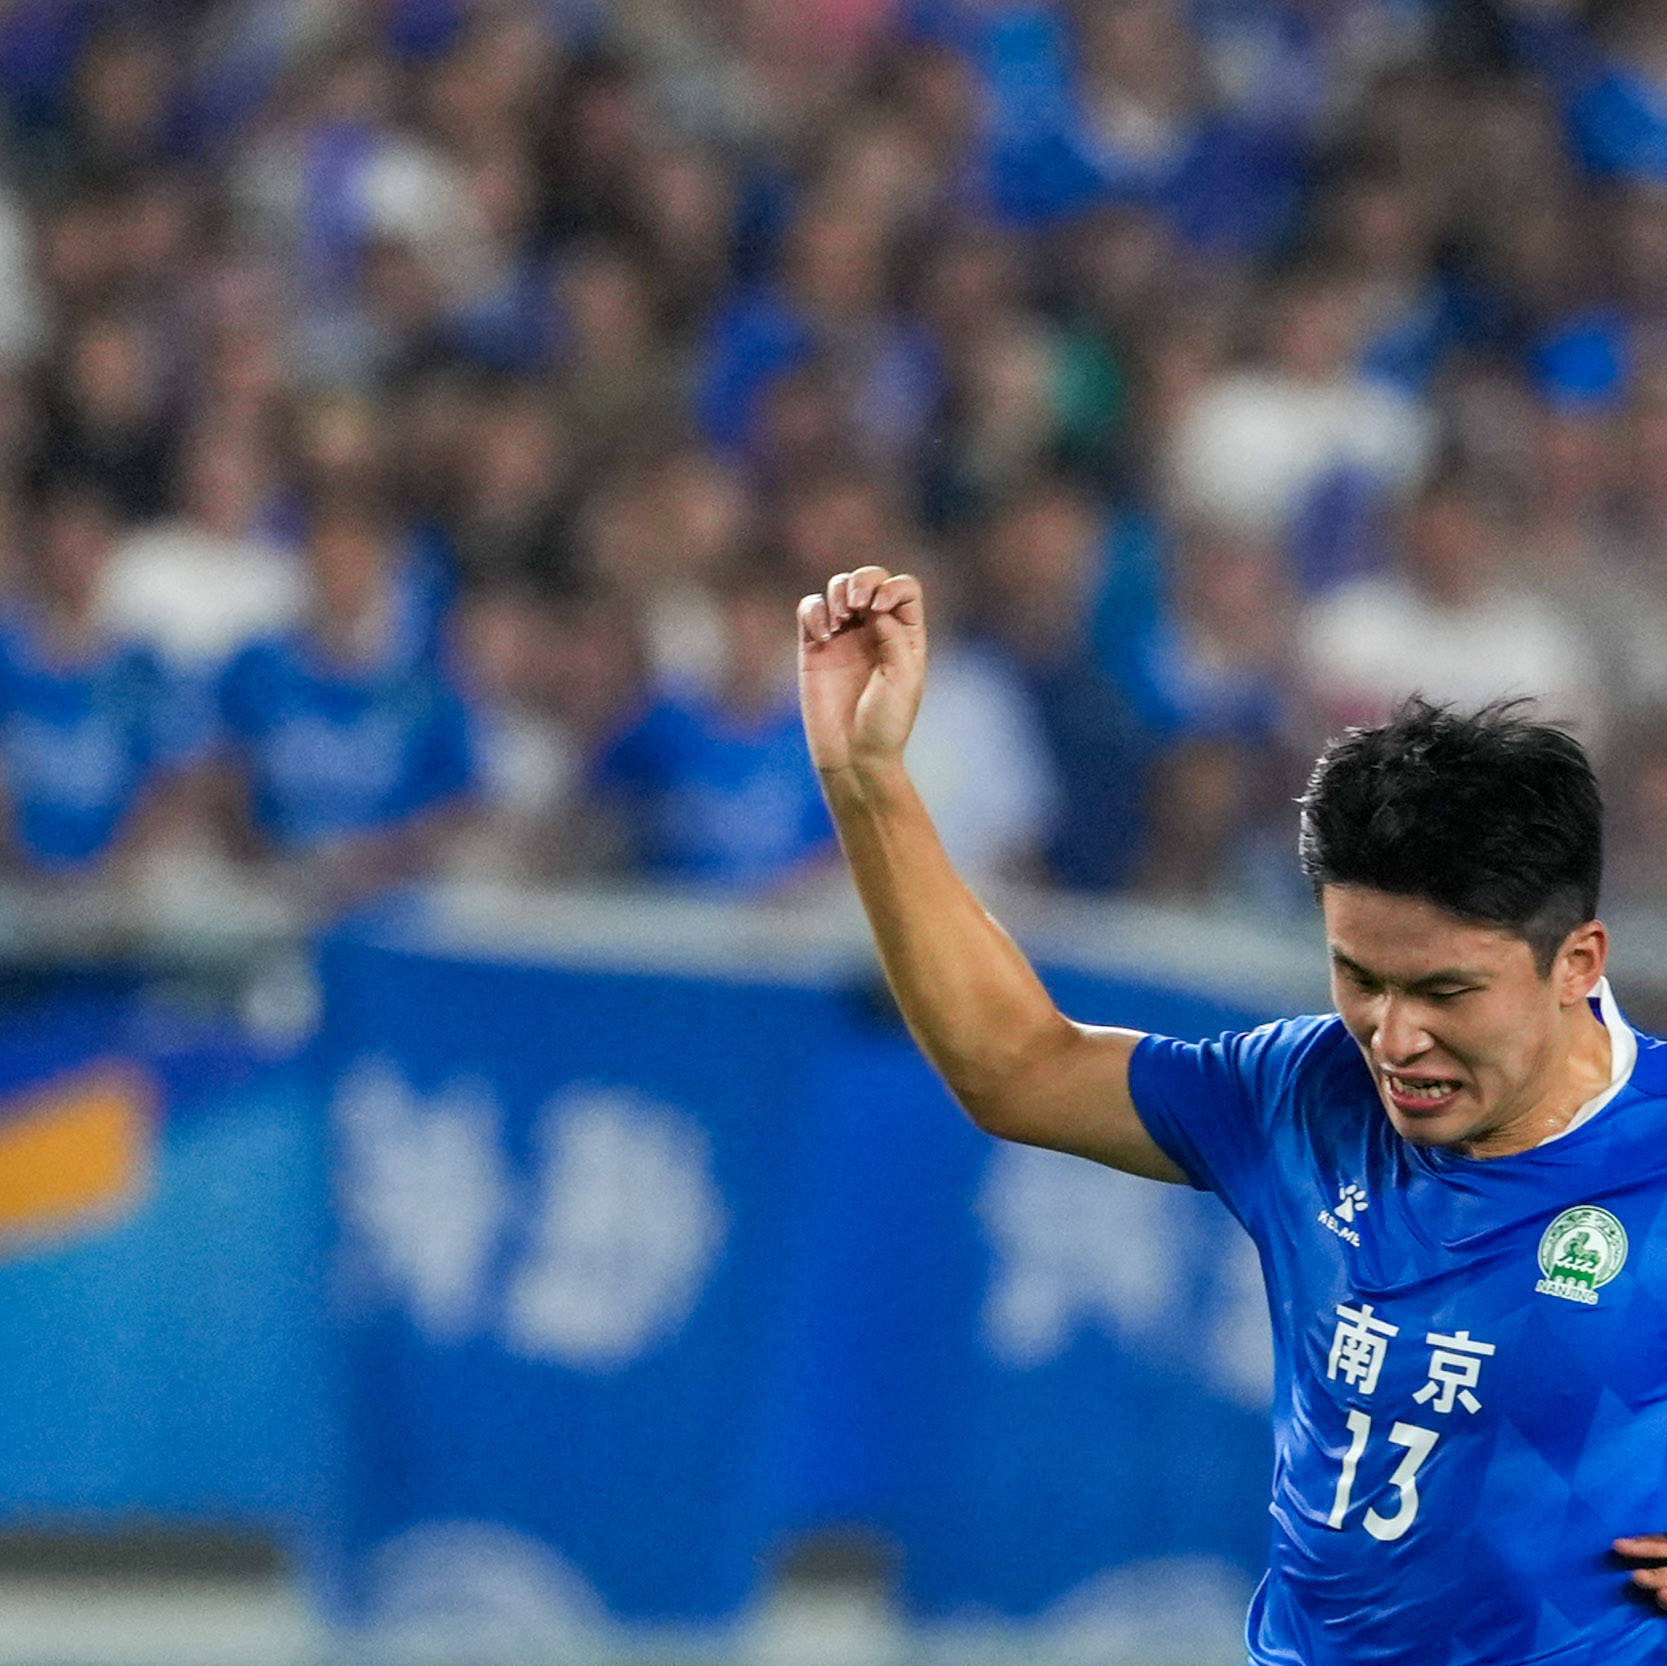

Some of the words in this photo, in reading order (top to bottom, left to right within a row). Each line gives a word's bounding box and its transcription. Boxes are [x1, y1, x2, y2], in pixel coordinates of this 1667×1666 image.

[1534, 1279, 1600, 1305] NANJING
[1326, 1303, 1497, 1414] 南京
[1326, 1408, 1440, 1542] 13
